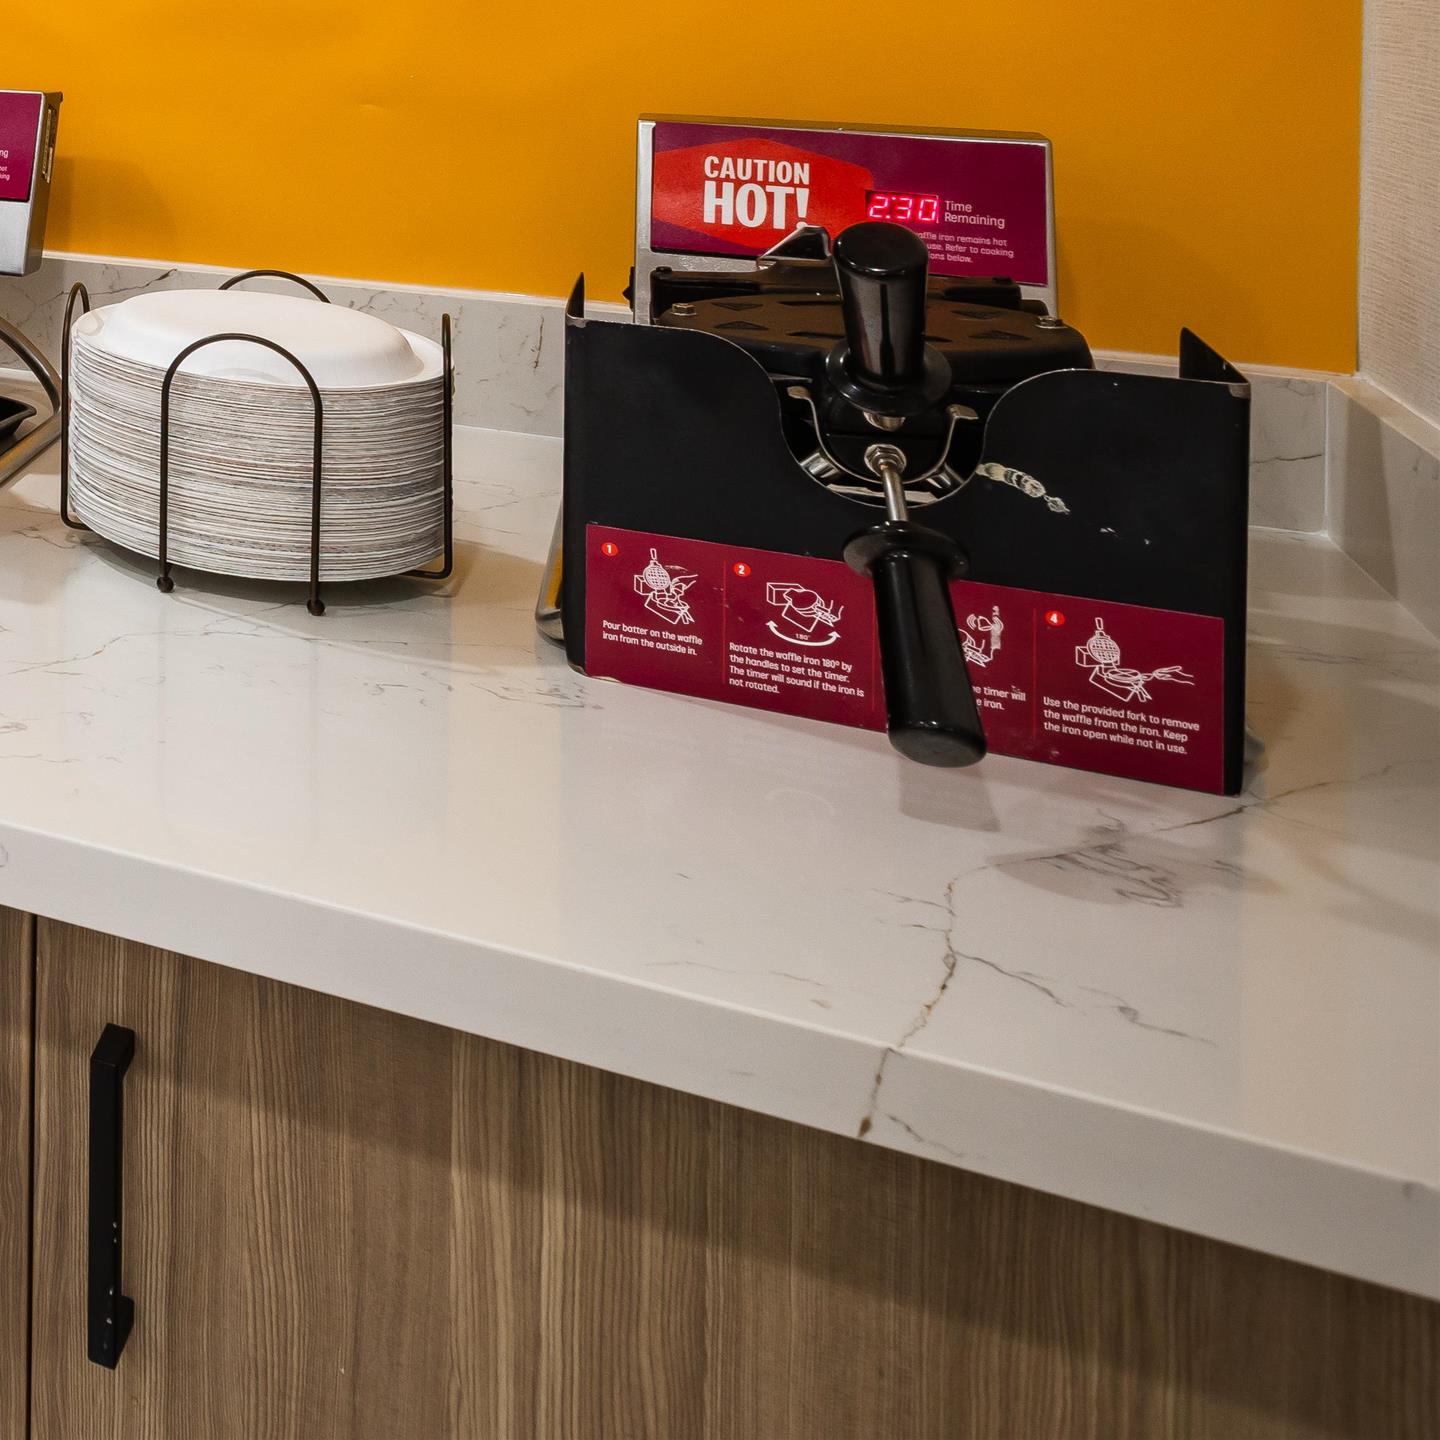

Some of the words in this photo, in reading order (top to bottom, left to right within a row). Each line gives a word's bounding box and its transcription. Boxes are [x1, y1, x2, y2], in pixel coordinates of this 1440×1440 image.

[704, 155, 810, 185] CAUTION
[703, 180, 810, 230] HOT!
[870, 196, 938, 221] 2:30
[945, 200, 972, 213] Time
[944, 212, 1006, 229] Remaining
[938, 233, 955, 242] iron
[957, 237, 991, 245] remains
[993, 238, 1007, 246] hot
[945, 244, 967, 252] Refer
[980, 247, 1014, 257] cooking
[947, 254, 972, 263] below.
[738, 565, 745, 575] 2
[1050, 613, 1058, 623] 4
[603, 620, 621, 631] Pour
[622, 623, 648, 635] batter
[662, 631, 676, 640] the
[677, 634, 703, 645] waffle
[603, 631, 619, 642] iron
[620, 634, 639, 645] from
[641, 639, 655, 648] the
[656, 643, 687, 654] outside
[688, 646, 697, 656] in.
[730, 642, 758, 654] Rotate
[760, 648, 774, 657] the
[776, 652, 802, 662] waffle
[803, 654, 821, 665] iron
[842, 661, 852, 673] by
[730, 654, 745, 664] the
[746, 657, 779, 670] handles
[781, 663, 791, 672] to
[792, 666, 805, 675] set
[808, 668, 822, 678] the
[824, 671, 849, 682] timer.
[729, 679, 744, 687] not
[745, 682, 779, 693] rotated.
[730, 665, 745, 675] The
[746, 669, 769, 680] timer
[771, 674, 785, 683] will
[786, 676, 812, 688] sound
[814, 680, 820, 689] if
[822, 682, 836, 692] the
[838, 685, 855, 695] iron
[857, 688, 864, 696] is
[983, 687, 1009, 698] timer
[1011, 691, 1026, 700] will
[984, 699, 1004, 710] iron.
[1043, 697, 1061, 707] Use
[1063, 700, 1080, 710] the
[1081, 705, 1125, 717] provided
[1127, 710, 1147, 721] fork
[1149, 714, 1160, 723] to
[1162, 717, 1200, 729] remove
[1044, 710, 1061, 720] the
[1062, 714, 1092, 725] waffle
[1094, 718, 1118, 729] from
[1121, 723, 1138, 733] the
[1139, 725, 1161, 736] iron.
[1164, 729, 1188, 743] Keep
[1044, 723, 1061, 732] the
[1062, 725, 1081, 736] iron
[1083, 730, 1108, 740] open
[1109, 734, 1135, 745] while
[1136, 739, 1153, 748] not
[1156, 740, 1165, 750] in
[1167, 744, 1187, 753] use.
